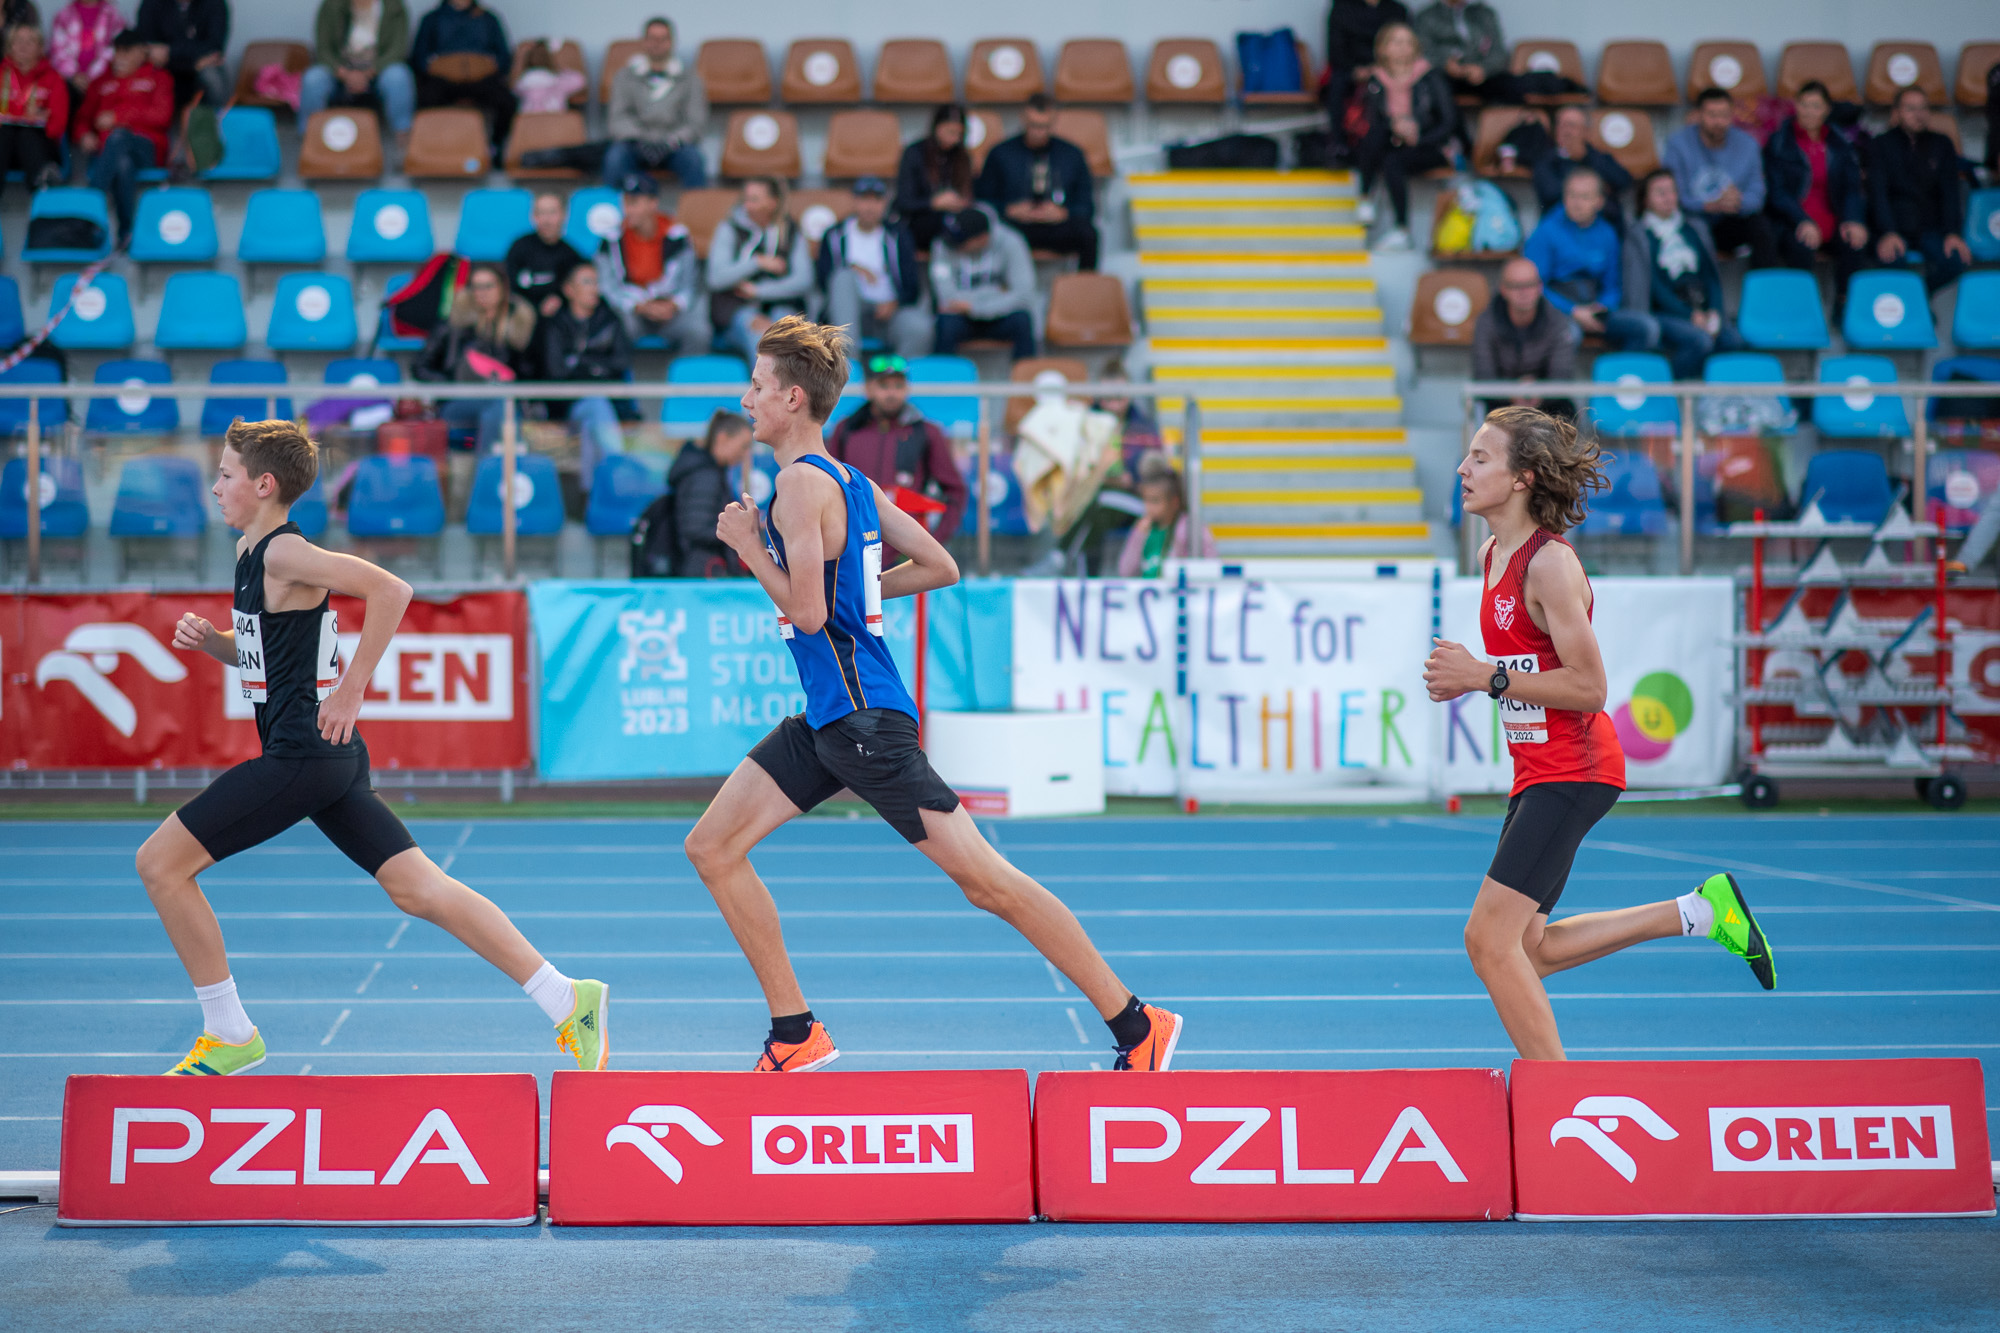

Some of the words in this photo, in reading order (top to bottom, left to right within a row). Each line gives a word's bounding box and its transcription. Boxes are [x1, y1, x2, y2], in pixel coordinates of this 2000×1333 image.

[236, 616, 255, 637] 404
[1291, 599, 1366, 663] for
[362, 652, 489, 703] LEN
[710, 652, 798, 686] STOL
[623, 706, 689, 735] 2023
[1448, 690, 1500, 764] KI
[1513, 731, 1535, 740] 2022
[109, 1107, 490, 1185] PZLA
[764, 1124, 958, 1165] ORLEN
[1089, 1106, 1469, 1184] PZLA
[1724, 1116, 1938, 1162] ORLEN
